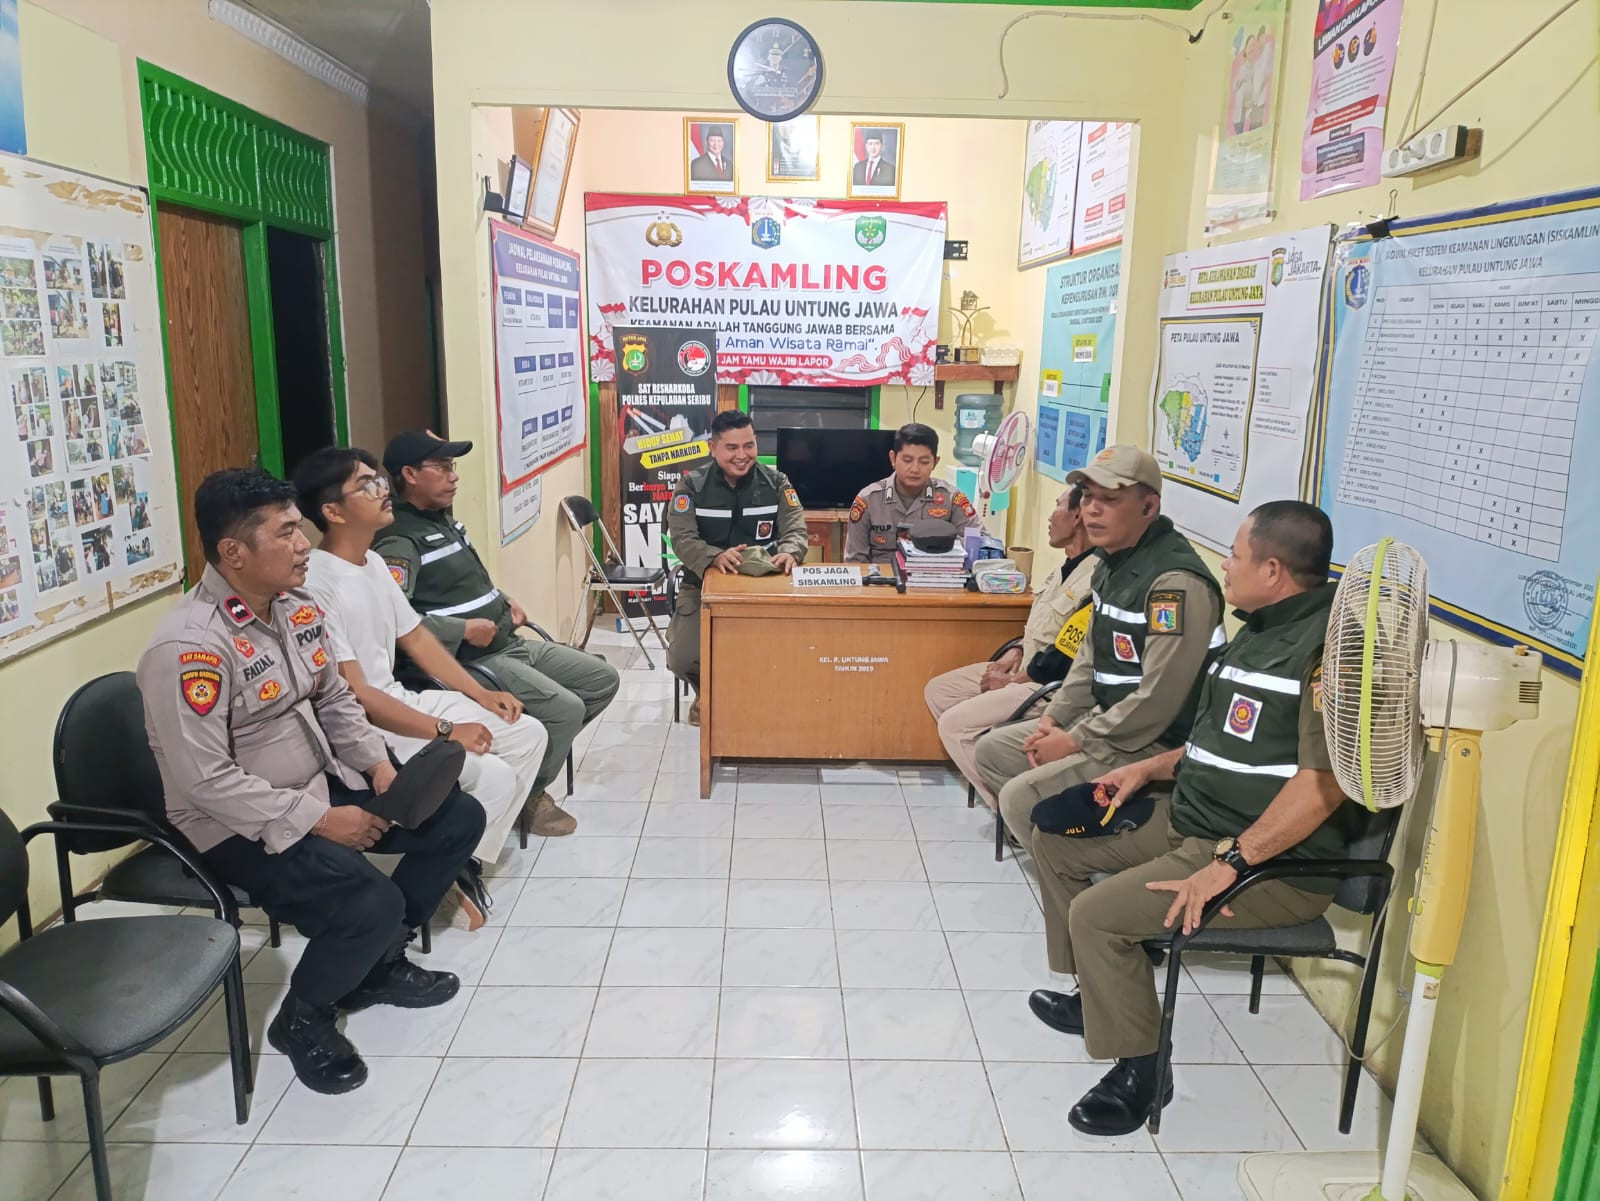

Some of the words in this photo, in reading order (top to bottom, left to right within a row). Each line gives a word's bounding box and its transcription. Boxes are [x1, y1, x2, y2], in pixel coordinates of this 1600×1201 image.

[1425, 243, 1448, 257] SISTEM
[1448, 240, 1489, 254] KEAMANAN
[1490, 234, 1546, 250] LINGKUNGAN
[1547, 224, 1600, 245] (SISKAMLIN
[1459, 262, 1483, 275] PULAU
[1484, 259, 1517, 273] UNTUNG
[1518, 256, 1543, 270] JAWA
[641, 259, 887, 291] POSKAMLING
[1060, 270, 1088, 289] STRUKTUR
[1088, 262, 1119, 284] ORGANISA
[629, 296, 725, 315] KELURAHAN
[729, 299, 781, 316] PULAU
[785, 300, 850, 318] UNTUNG
[854, 301, 898, 318] JAWA
[742, 322, 802, 334] TANGGUNG
[805, 323, 842, 335] JAWAB
[845, 324, 895, 336] BERSAMA
[725, 337, 764, 350] Aman
[769, 337, 821, 350] Wisata
[1170, 332, 1182, 343] PETA
[1183, 332, 1199, 343] PULAU
[1199, 332, 1221, 343] UNTUNG
[1222, 331, 1240, 344] JAWA
[721, 355, 739, 365] JAM
[742, 356, 766, 366] TAMU
[768, 356, 796, 367] WAJIB
[798, 357, 830, 367] LAPOR
[638, 383, 651, 394] SAT
[622, 394, 647, 405] POLRES
[648, 394, 687, 405] KEPULAUAN
[687, 394, 711, 406] SERIBU
[637, 435, 660, 449] HIDUP
[661, 430, 684, 445] SEHAT
[649, 453, 670, 464] TANPA
[670, 444, 701, 460] NARKOBA
[623, 502, 665, 524] SAY
[802, 567, 822, 575] POS
[824, 567, 849, 575] JAGA
[798, 577, 857, 587] SISKAMLING
[1065, 825, 1086, 835] JULI
